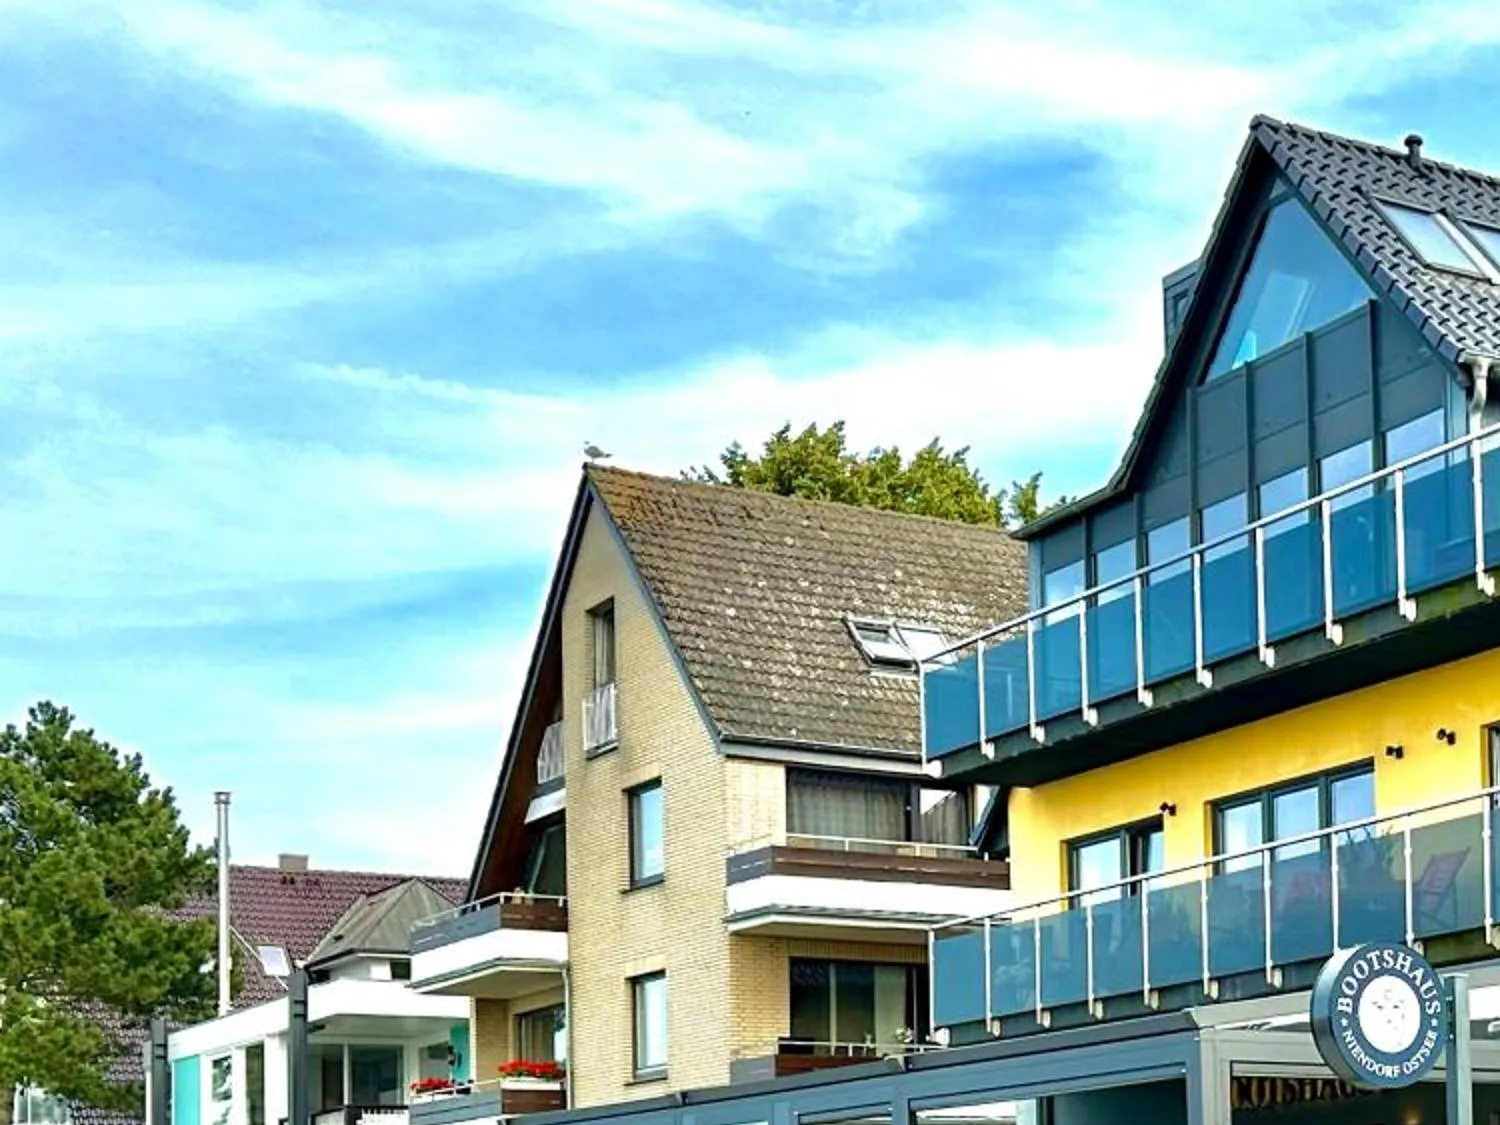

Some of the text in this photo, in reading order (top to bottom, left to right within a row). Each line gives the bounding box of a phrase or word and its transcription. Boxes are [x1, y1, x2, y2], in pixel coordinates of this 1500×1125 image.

[1337, 949, 1441, 1016] BOOTSHAUS
[1342, 1029, 1439, 1079] NIENDORF OSTSEE
